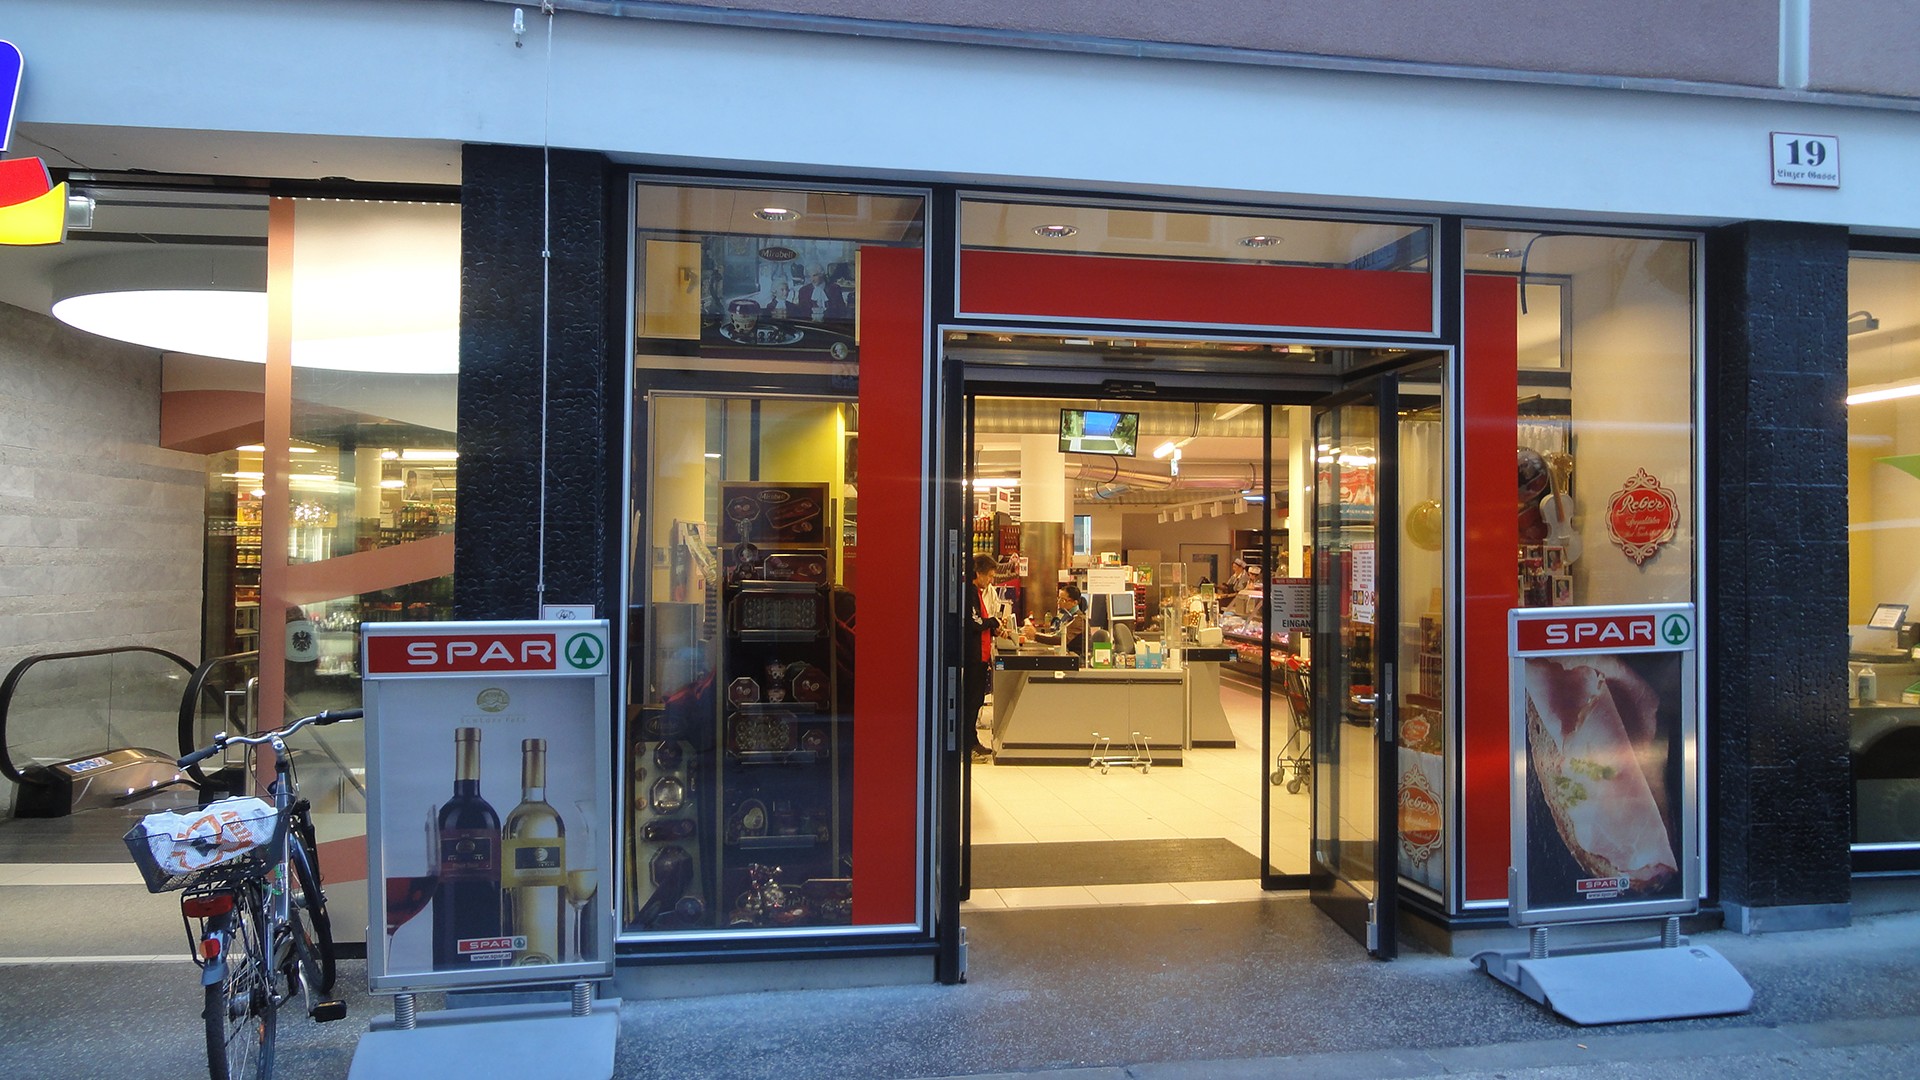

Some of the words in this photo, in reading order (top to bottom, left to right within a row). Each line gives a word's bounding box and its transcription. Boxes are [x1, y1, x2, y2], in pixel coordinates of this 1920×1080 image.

[1786, 139, 1826, 167] 19
[1777, 169, 1805, 180] Linzer
[1807, 170, 1837, 181] Gasse
[1616, 494, 1667, 515] Reber
[1282, 619, 1311, 628] EINGAN
[1546, 621, 1652, 644] SPAR
[407, 641, 552, 665] SPAR
[1399, 790, 1435, 815] Reber
[1585, 880, 1617, 888] SPAR
[469, 940, 511, 949] SPAR
